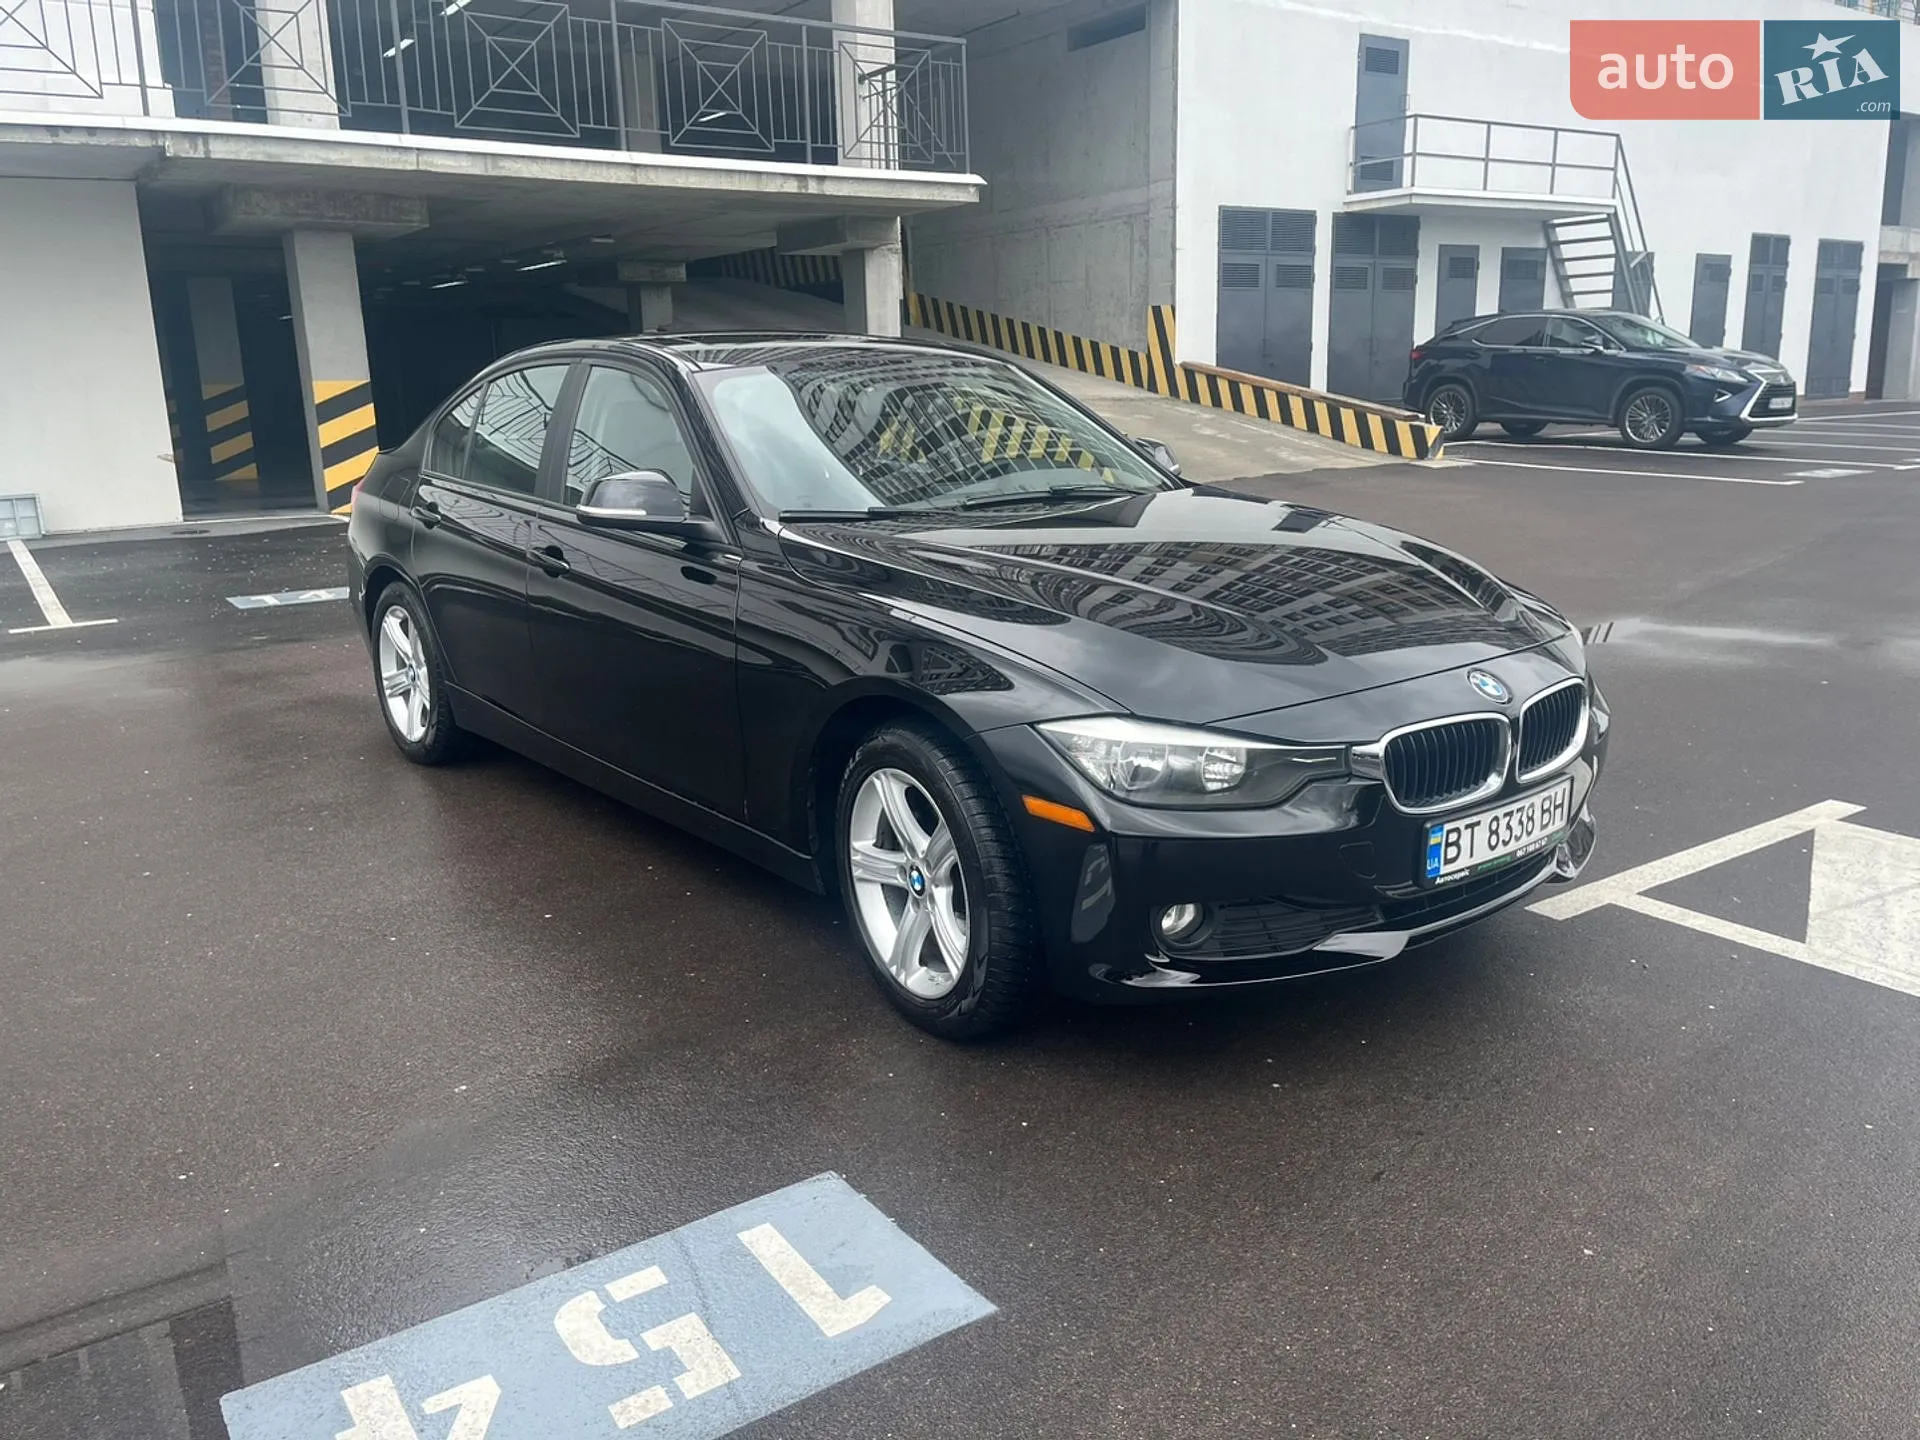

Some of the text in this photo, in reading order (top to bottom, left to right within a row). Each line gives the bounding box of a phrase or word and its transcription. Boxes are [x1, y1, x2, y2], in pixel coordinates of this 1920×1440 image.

[1443, 787, 1567, 866] BT 8338 BH
[1426, 857, 1440, 870] UA
